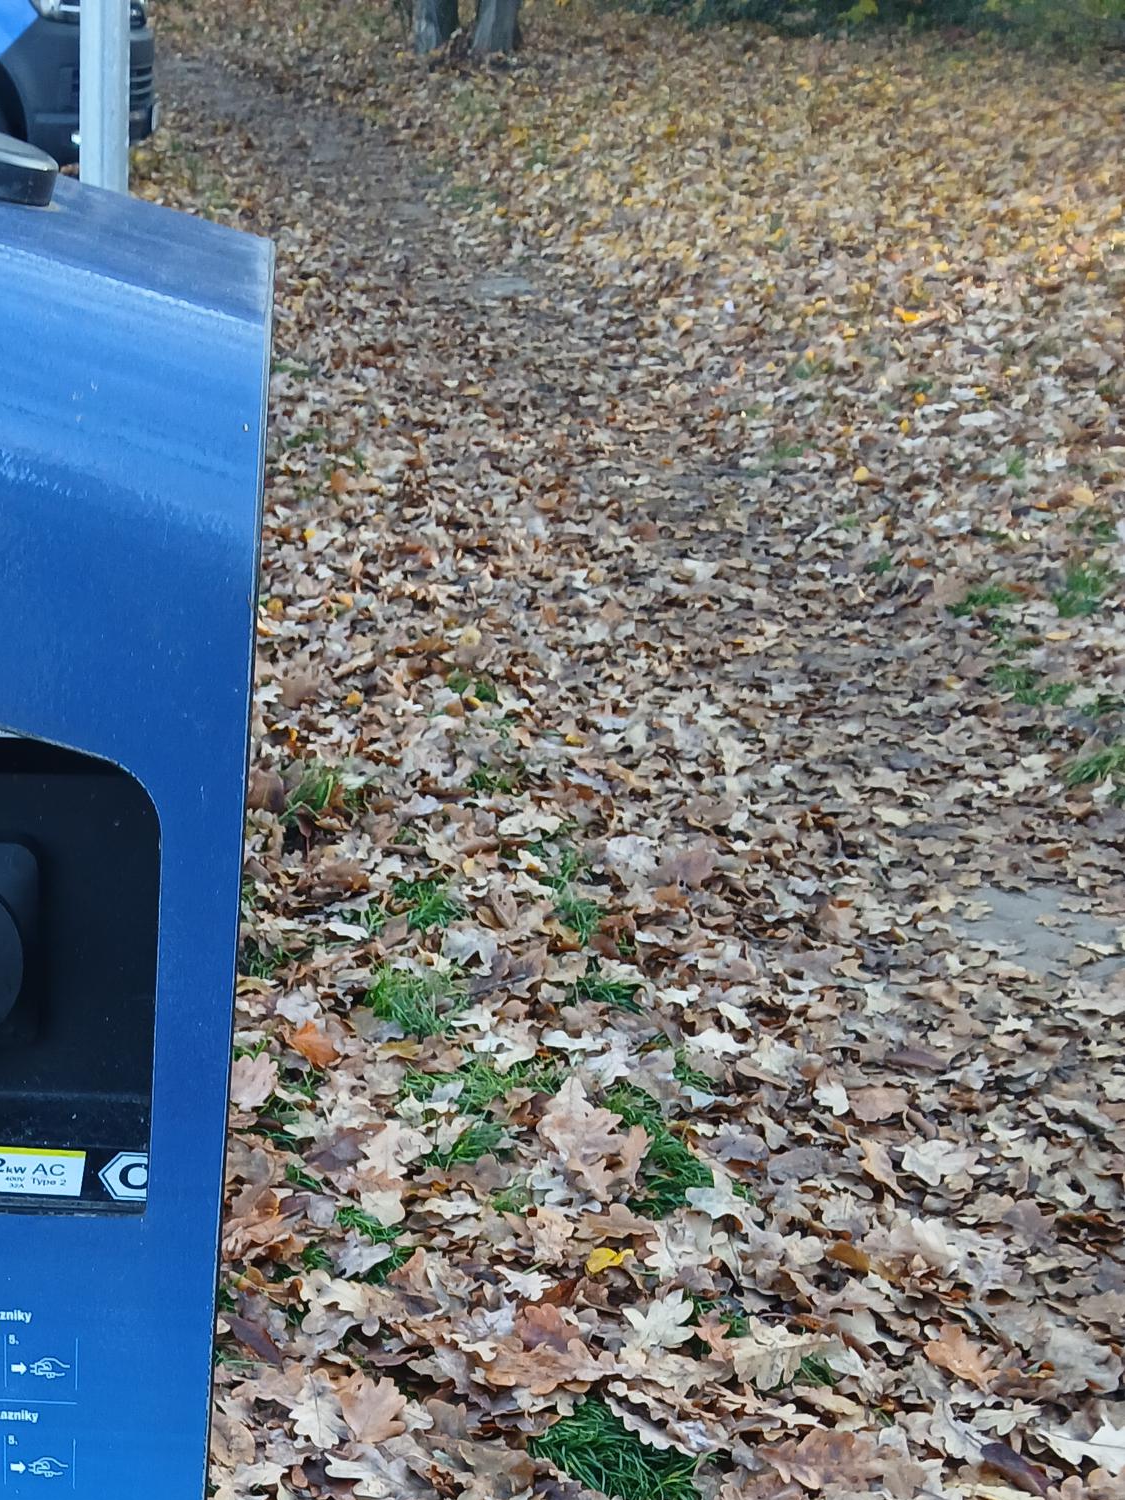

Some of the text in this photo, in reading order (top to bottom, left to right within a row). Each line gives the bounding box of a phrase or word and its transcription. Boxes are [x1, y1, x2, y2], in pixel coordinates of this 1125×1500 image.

[32, 1163, 65, 1177] AC
[30, 1176, 57, 1187] Type
[59, 1179, 67, 1187] 2
[8, 1334, 19, 1345] 5.
[7, 1435, 18, 1445] 5.
